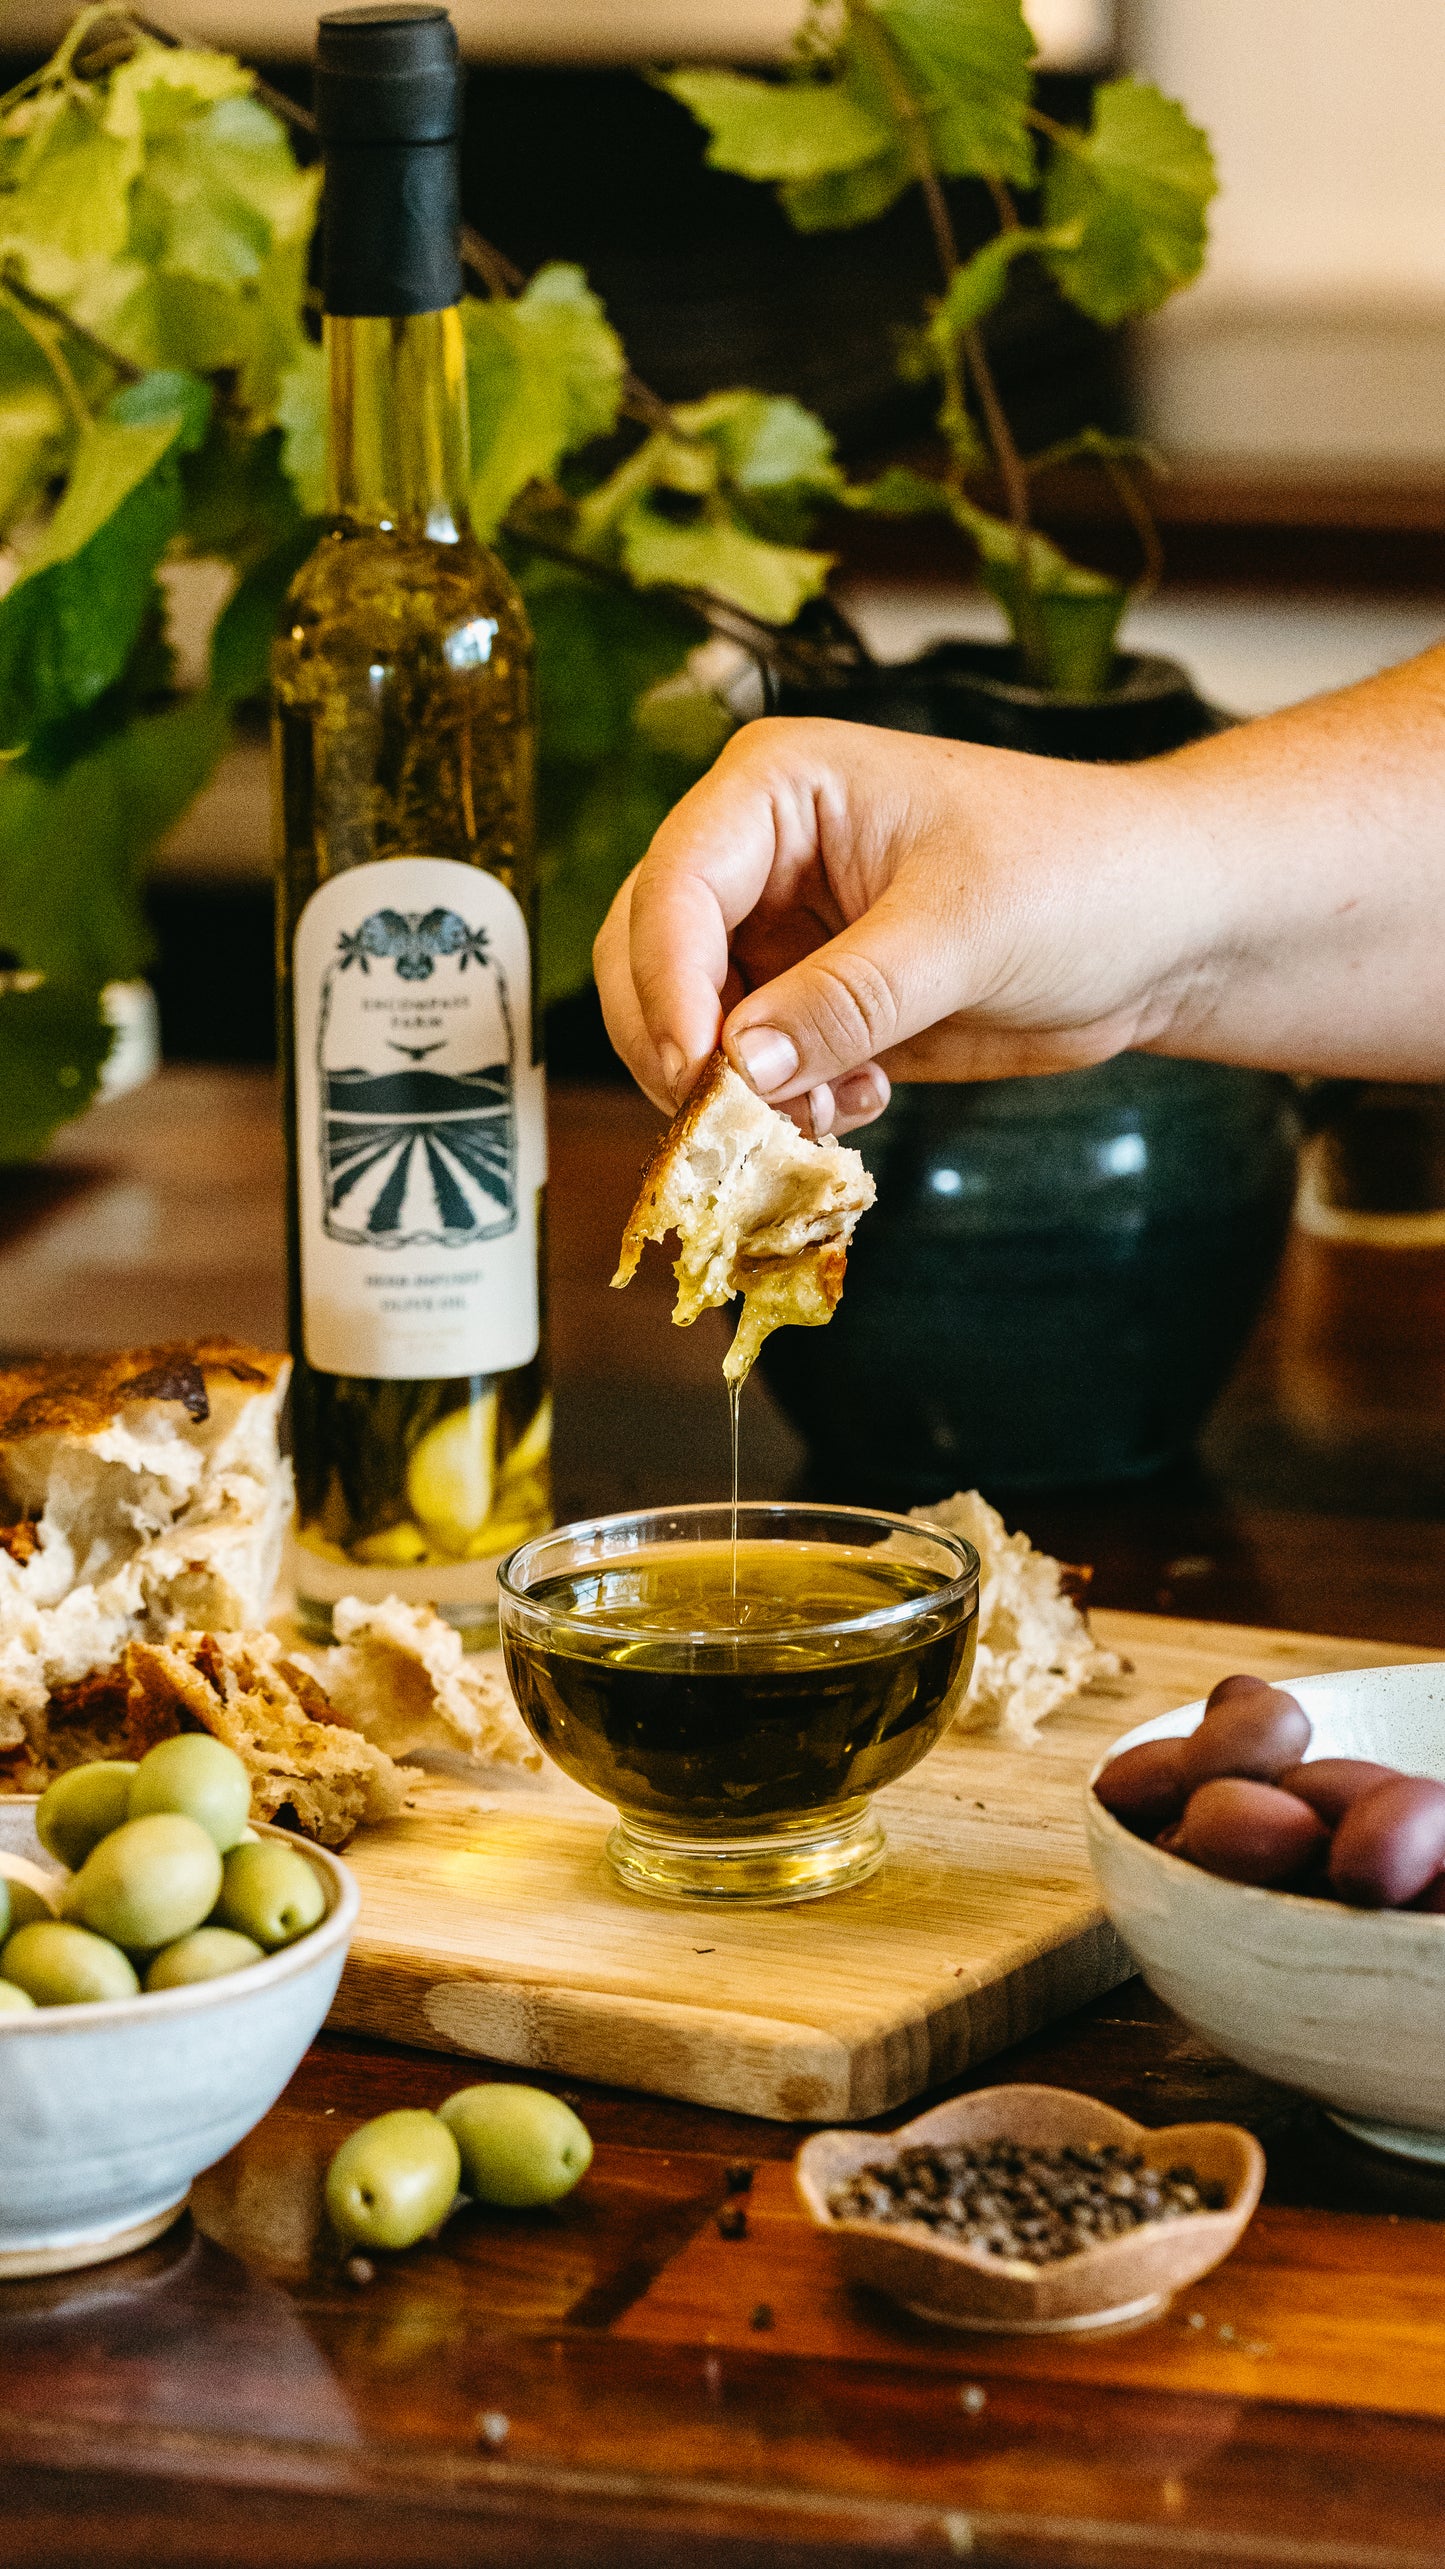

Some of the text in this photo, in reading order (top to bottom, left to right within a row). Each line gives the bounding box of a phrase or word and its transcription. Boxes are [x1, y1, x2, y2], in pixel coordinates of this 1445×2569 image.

[361, 997, 470, 1012] ENCOMPASS
[390, 1015, 442, 1029] FARM
[381, 1296, 467, 1312] OLIVE OIL
